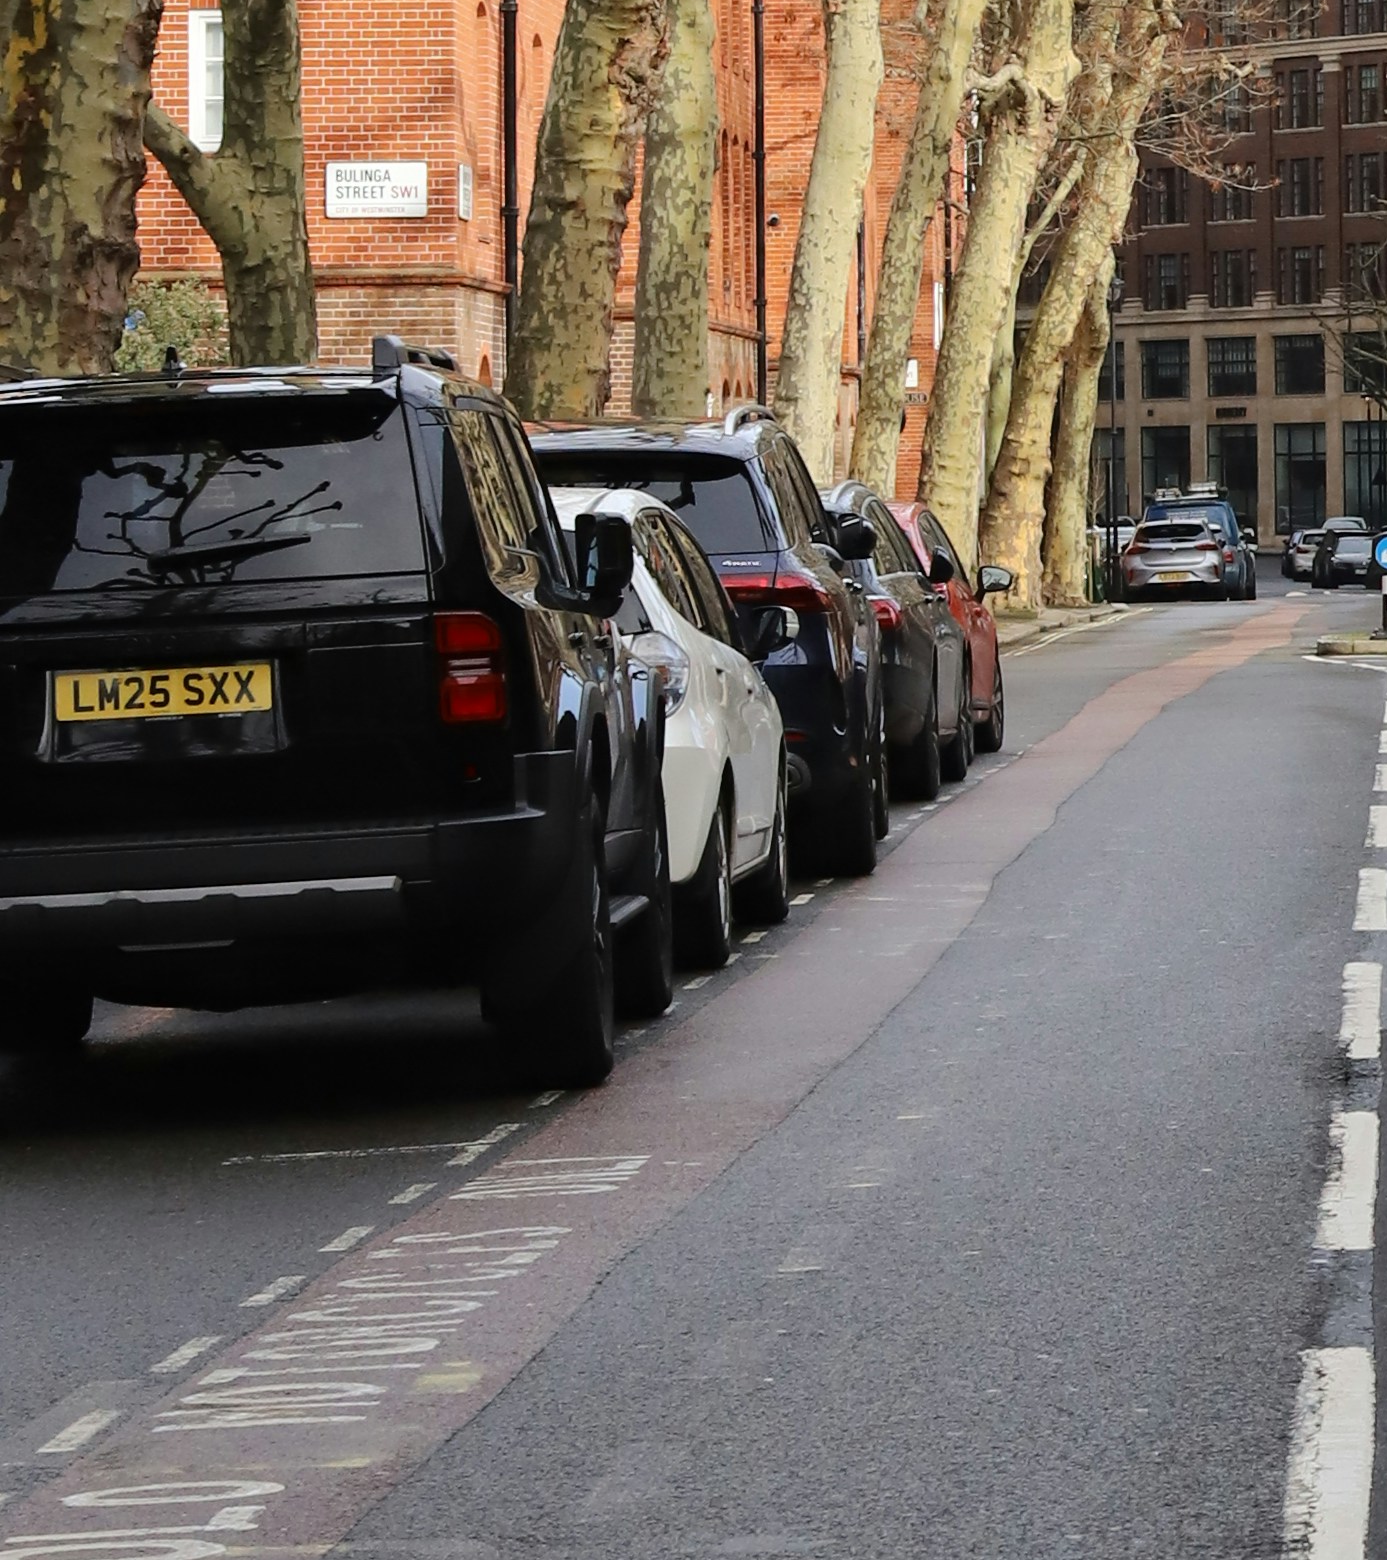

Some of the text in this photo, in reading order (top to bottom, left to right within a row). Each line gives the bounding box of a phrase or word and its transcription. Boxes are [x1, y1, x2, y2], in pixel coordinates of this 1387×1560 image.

[335, 169, 391, 183] BULINGA
[335, 185, 418, 199] STREET SW1
[73, 670, 256, 713] LM25 SXX
